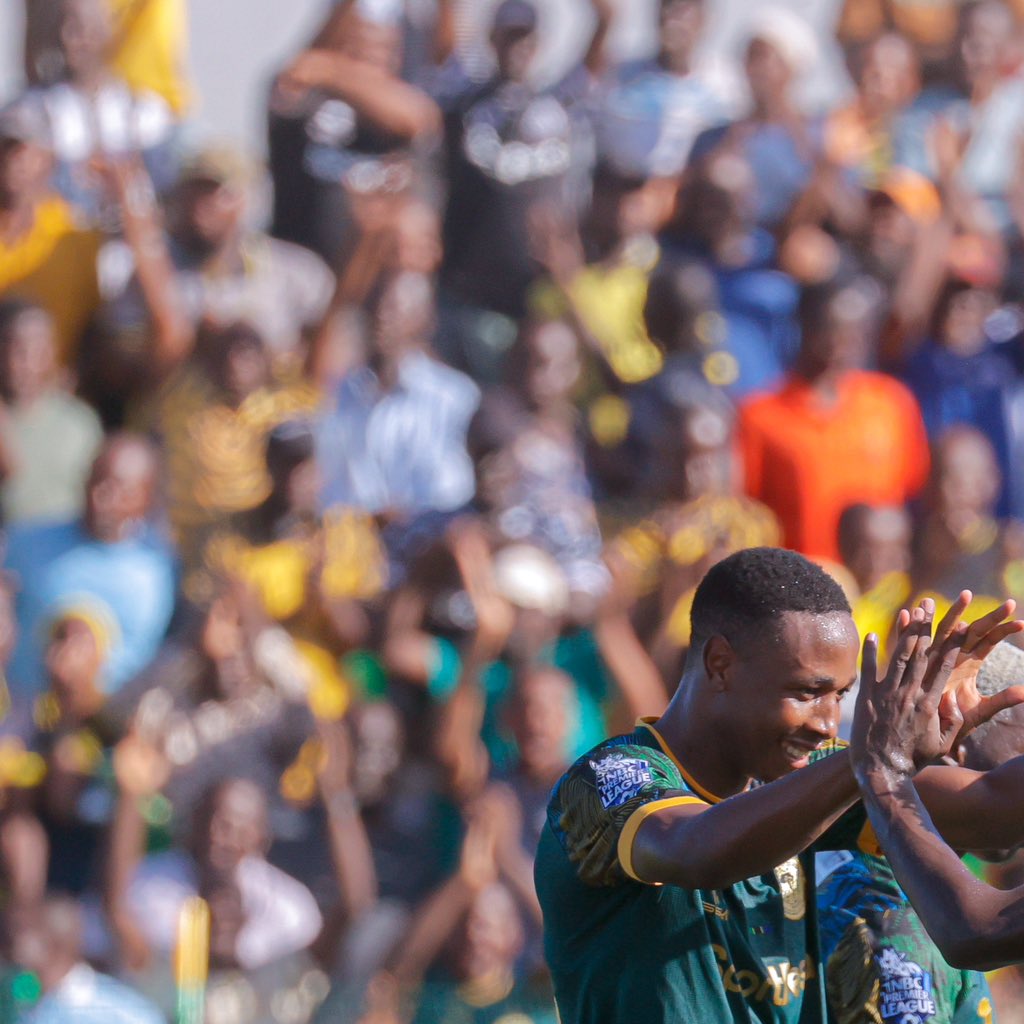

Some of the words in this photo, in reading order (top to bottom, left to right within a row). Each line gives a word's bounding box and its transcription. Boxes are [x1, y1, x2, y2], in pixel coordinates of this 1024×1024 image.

[601, 772, 651, 808] LEAGUE
[891, 977, 923, 991] NBC
[881, 999, 937, 1019] LEAGUE
